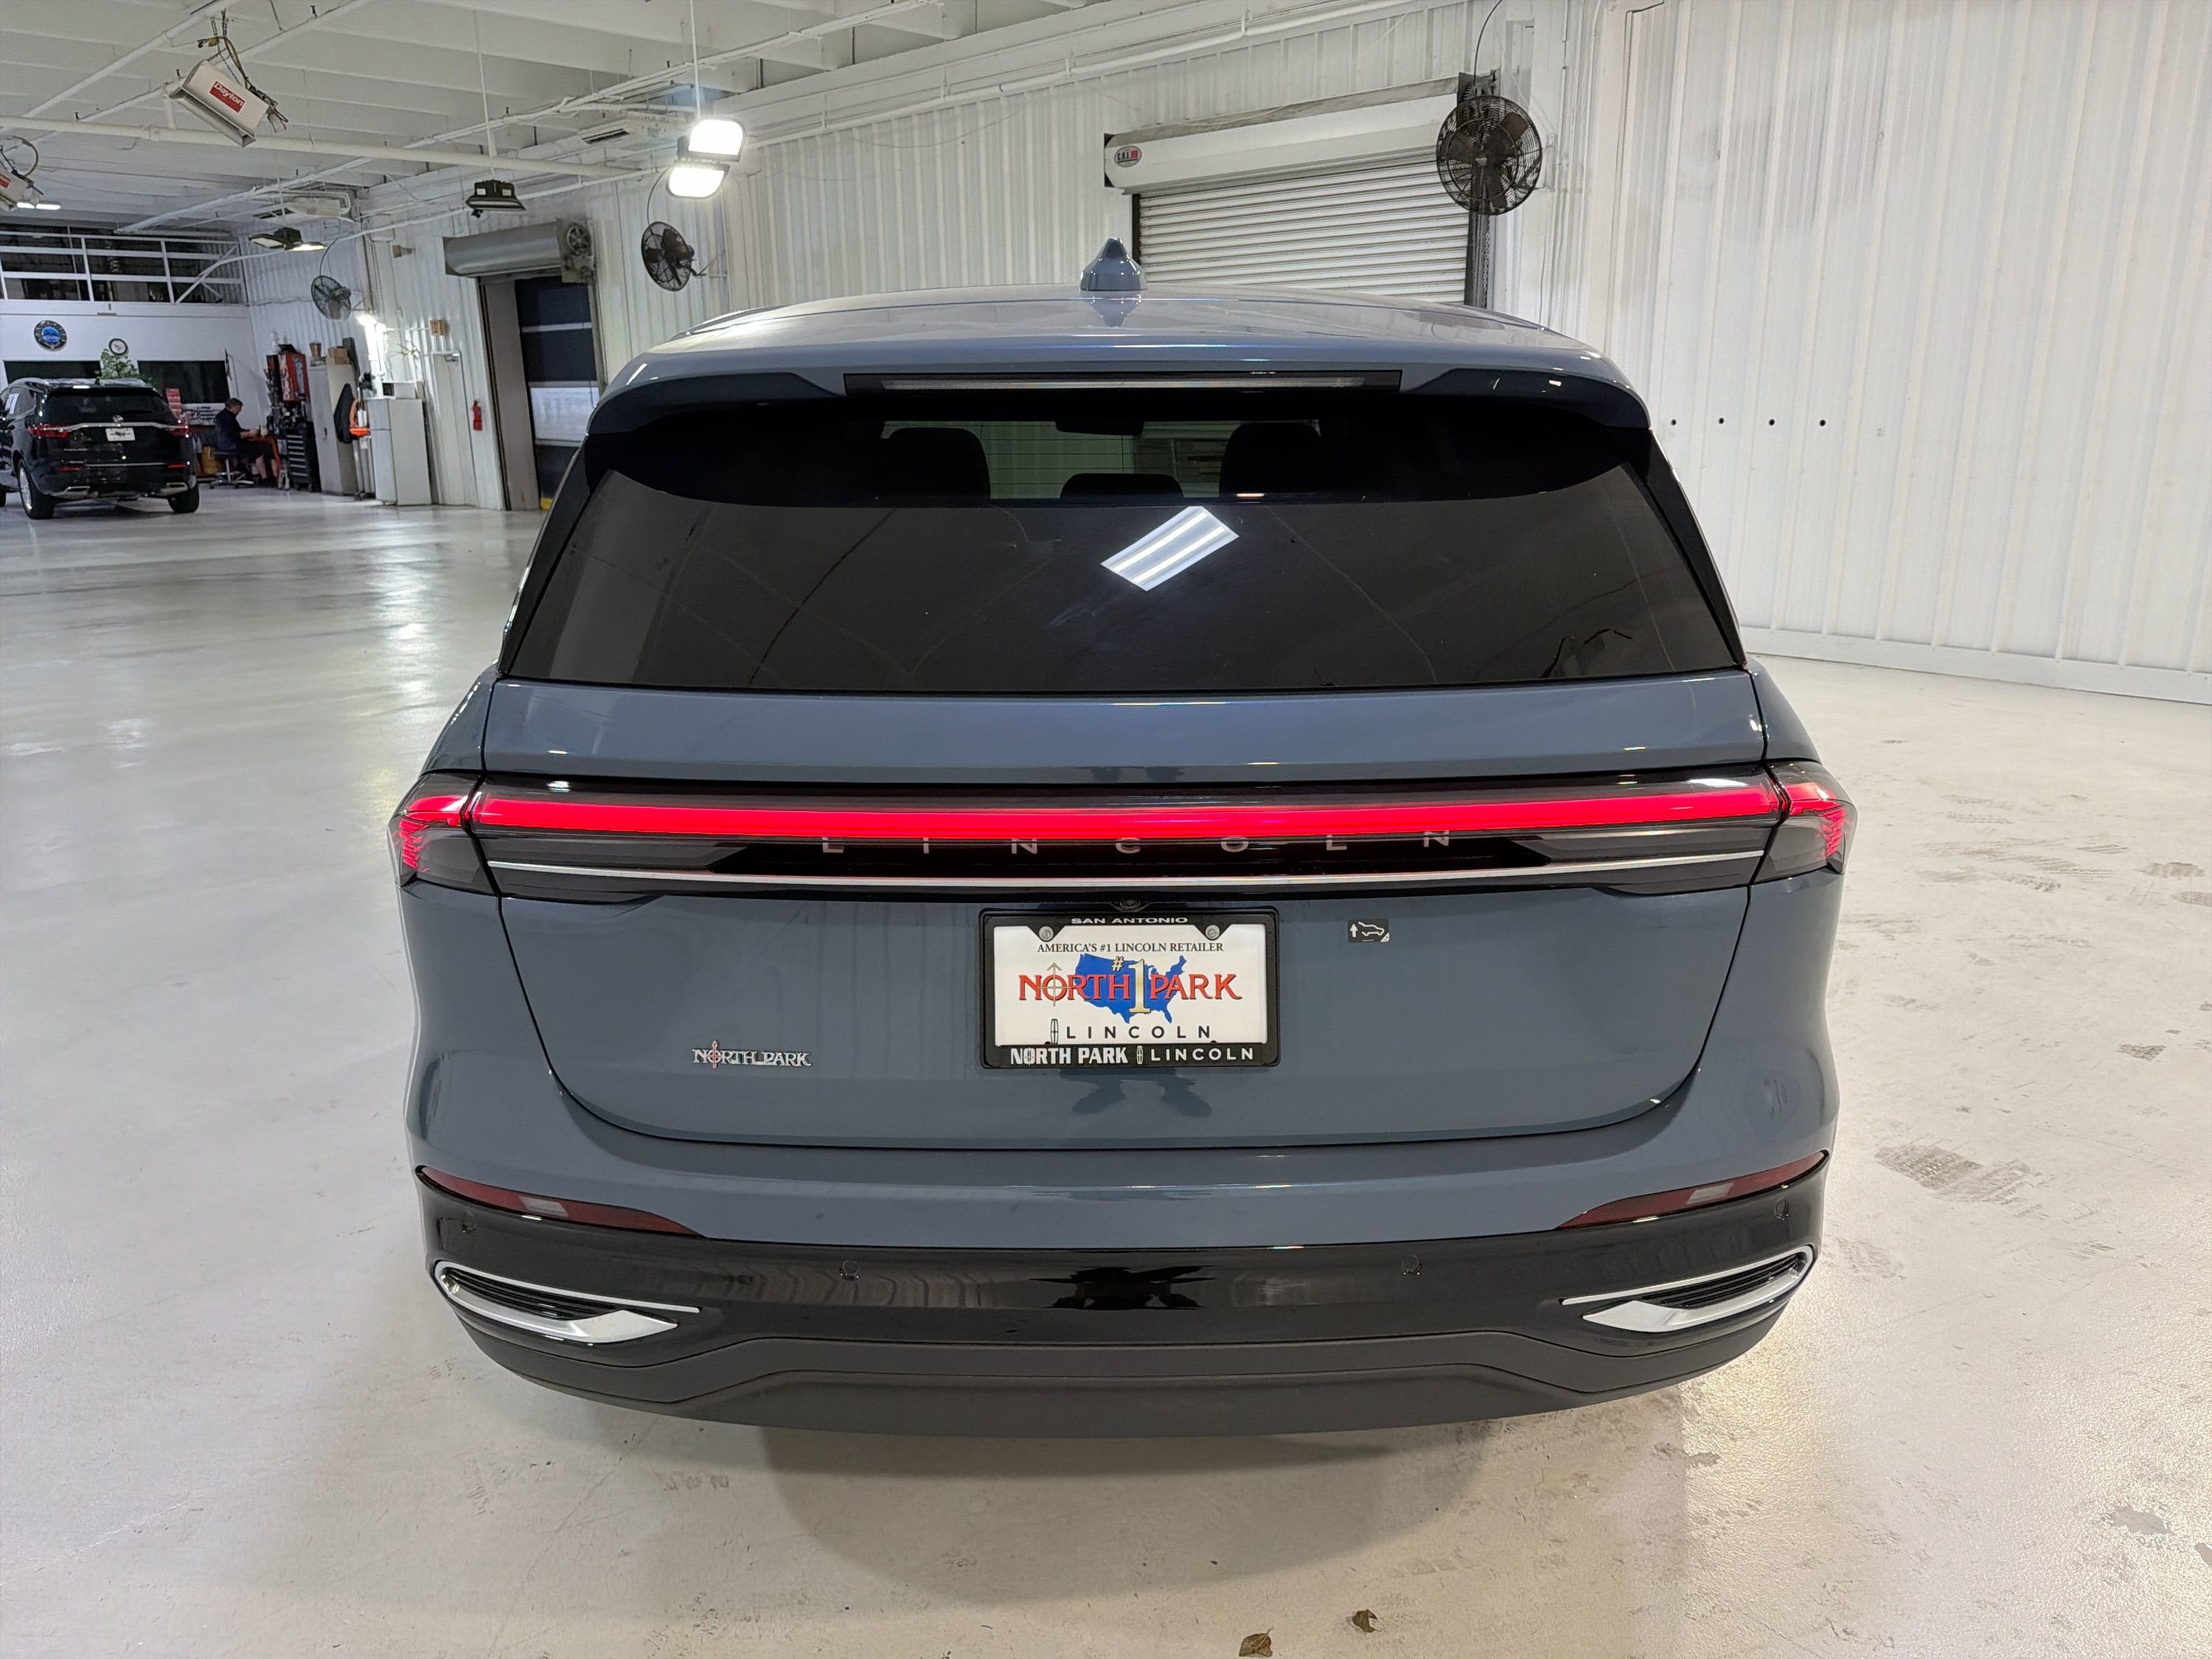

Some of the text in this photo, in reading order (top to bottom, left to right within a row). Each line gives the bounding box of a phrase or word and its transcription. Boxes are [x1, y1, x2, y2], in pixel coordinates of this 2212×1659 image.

[213, 82, 243, 106] Dayton
[822, 830, 1450, 854] LINCOLN
[1071, 917, 1188, 925] SAN ANTONIO
[1037, 942, 1224, 953] AMERICA'S #1 LINCOLN RETAILER
[1018, 973, 1243, 1001] NORTH PARK
[1066, 1026, 1211, 1040] LINCOLN
[1010, 1046, 1254, 1065] NORTH PARK LINCOLN
